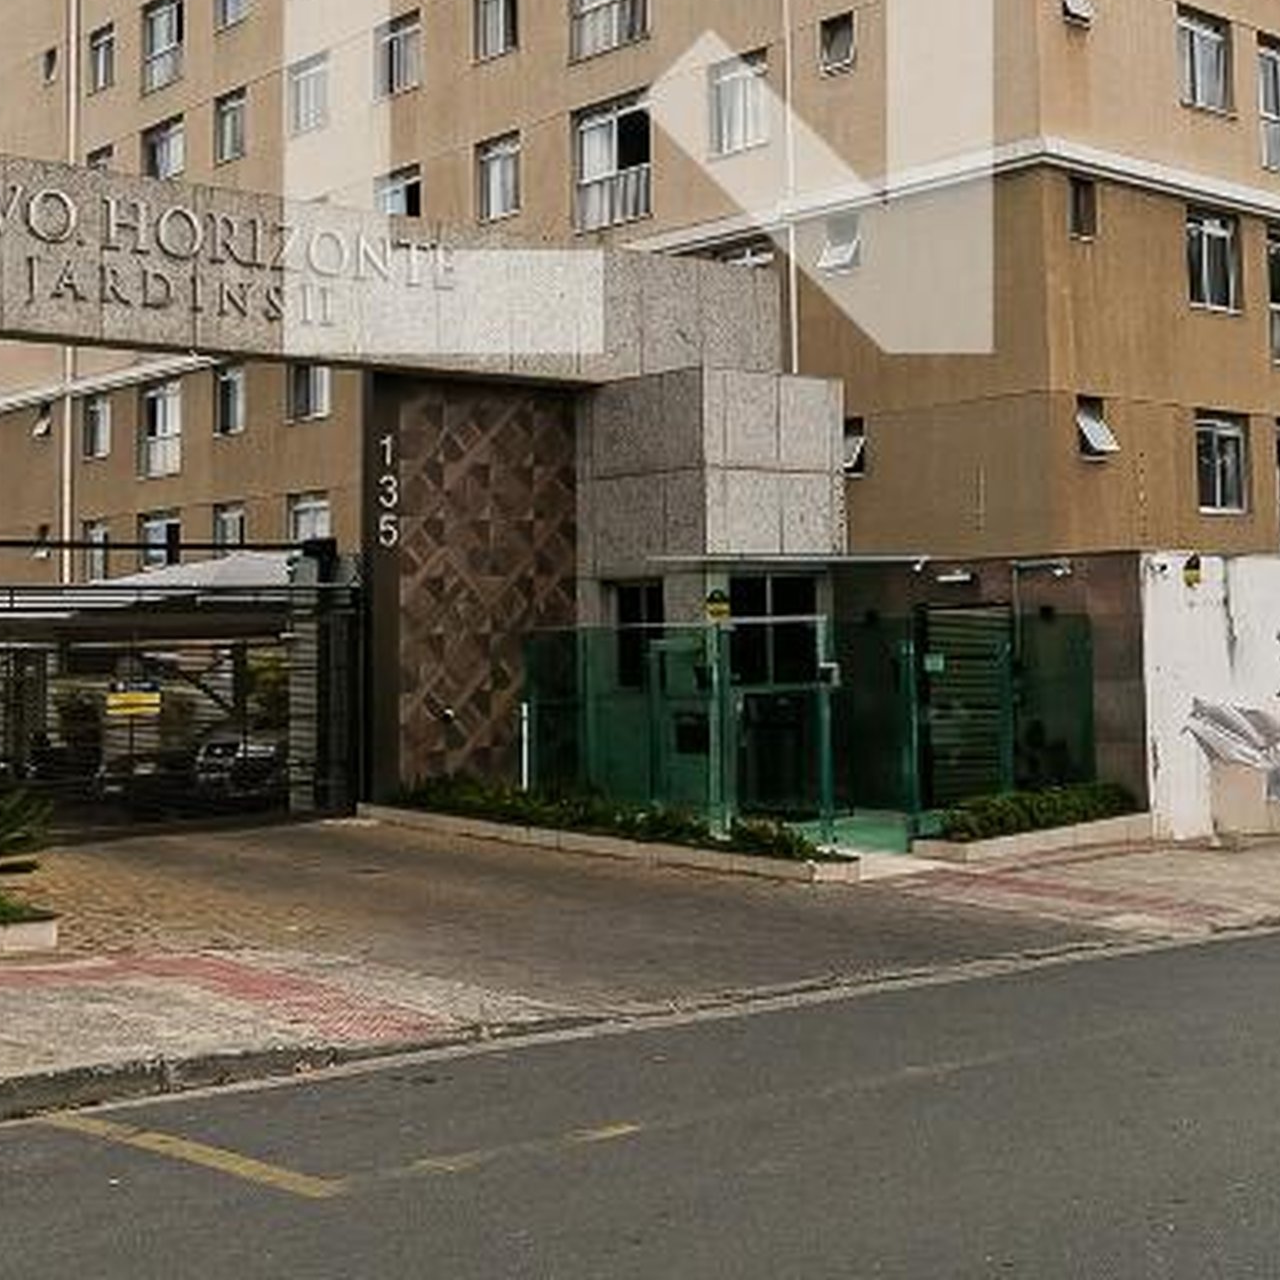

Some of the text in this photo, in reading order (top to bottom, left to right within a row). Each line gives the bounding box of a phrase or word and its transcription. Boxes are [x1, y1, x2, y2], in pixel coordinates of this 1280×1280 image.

[25, 255, 287, 323] JARDINS
[99, 195, 455, 291] HORIZONTE
[379, 435, 398, 547] 135
